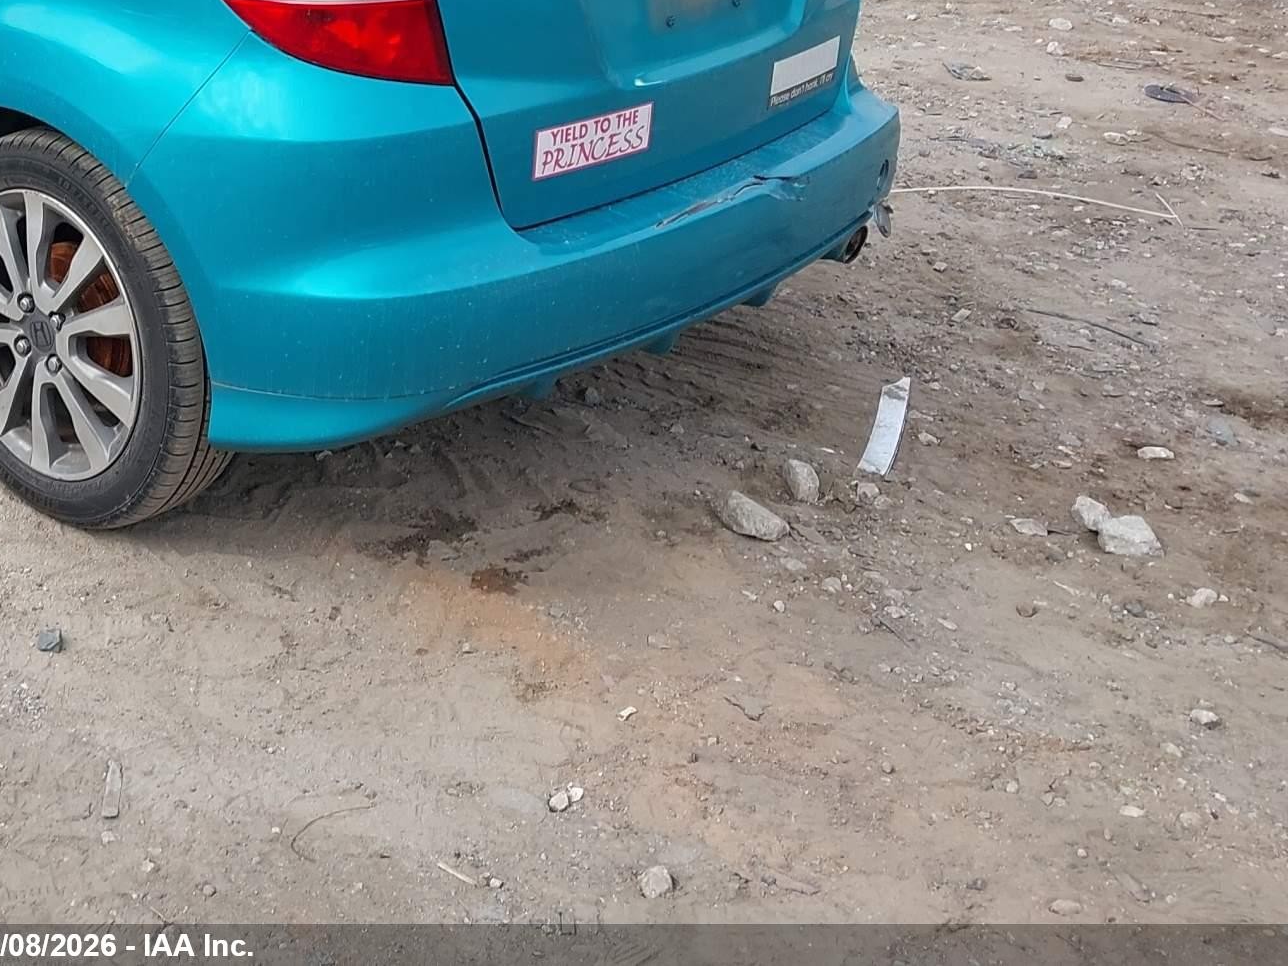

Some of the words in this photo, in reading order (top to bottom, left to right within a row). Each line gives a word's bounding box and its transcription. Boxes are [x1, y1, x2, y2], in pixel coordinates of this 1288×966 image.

[770, 92, 790, 107] Please
[551, 123, 588, 146] YIELD
[594, 117, 611, 135] TO
[616, 110, 639, 130] THE
[542, 125, 645, 175] PRINCESS
